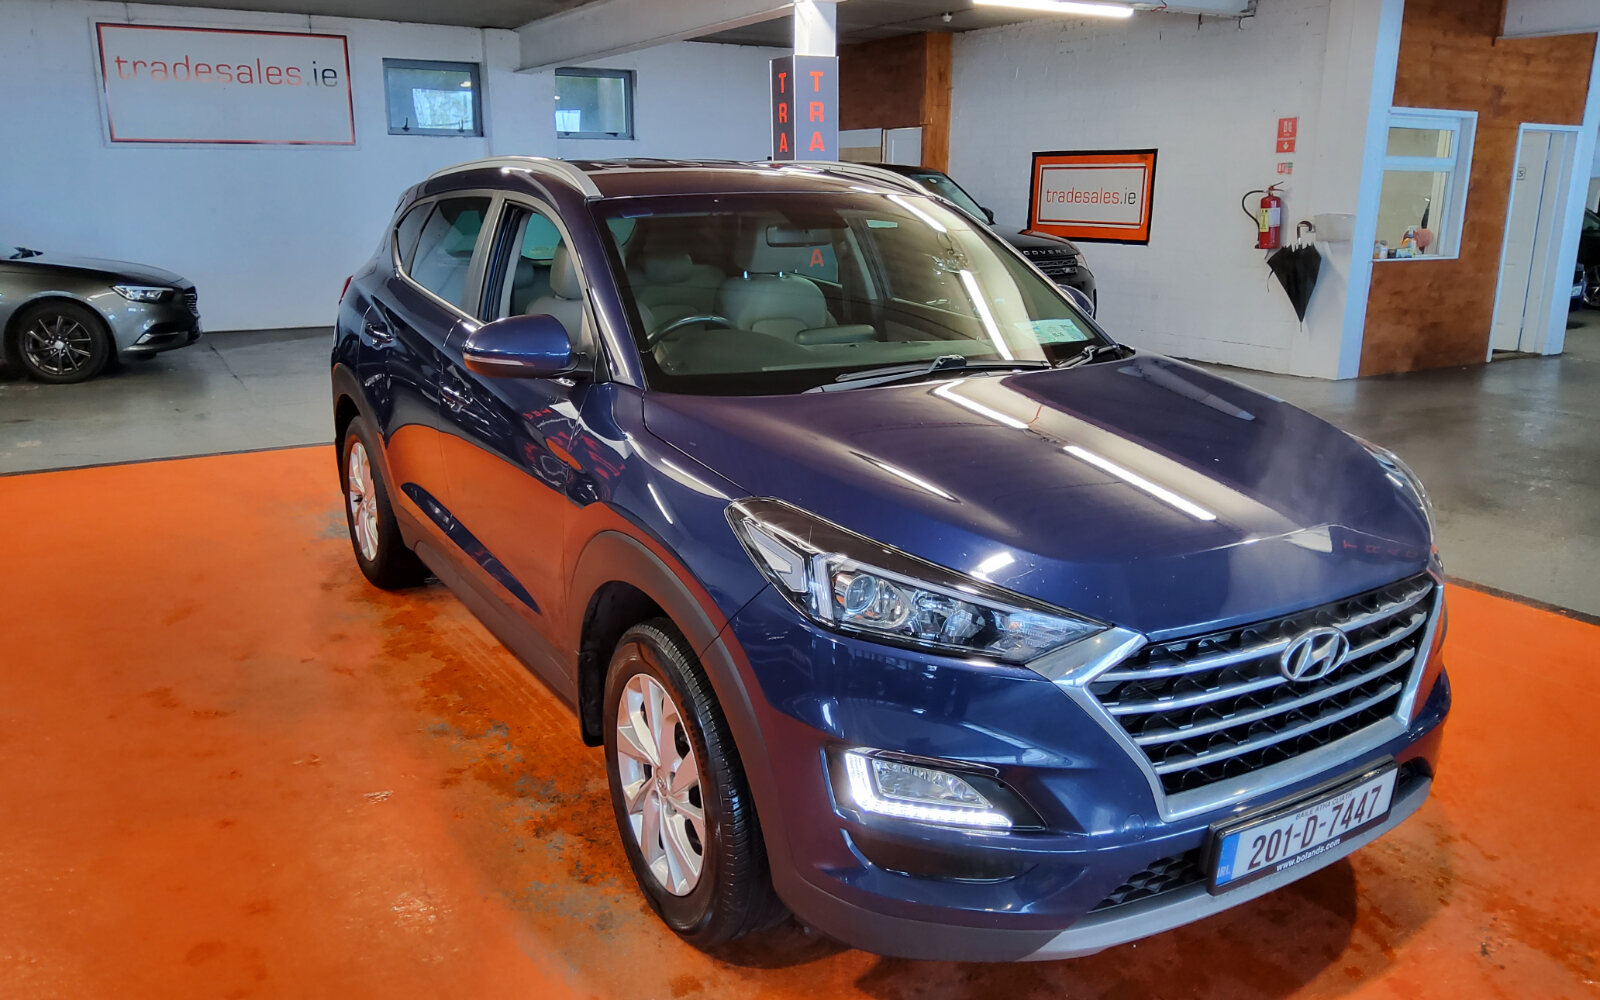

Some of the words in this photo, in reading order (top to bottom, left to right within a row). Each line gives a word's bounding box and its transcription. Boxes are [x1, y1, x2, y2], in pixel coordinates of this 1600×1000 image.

[114, 55, 338, 88] tradesales.ie
[1046, 187, 1137, 205] tradesales.ie
[1247, 785, 1382, 871] 201-D-7447
[1276, 838, 1341, 872] www.bolands.com
[1216, 865, 1231, 879] IRL
